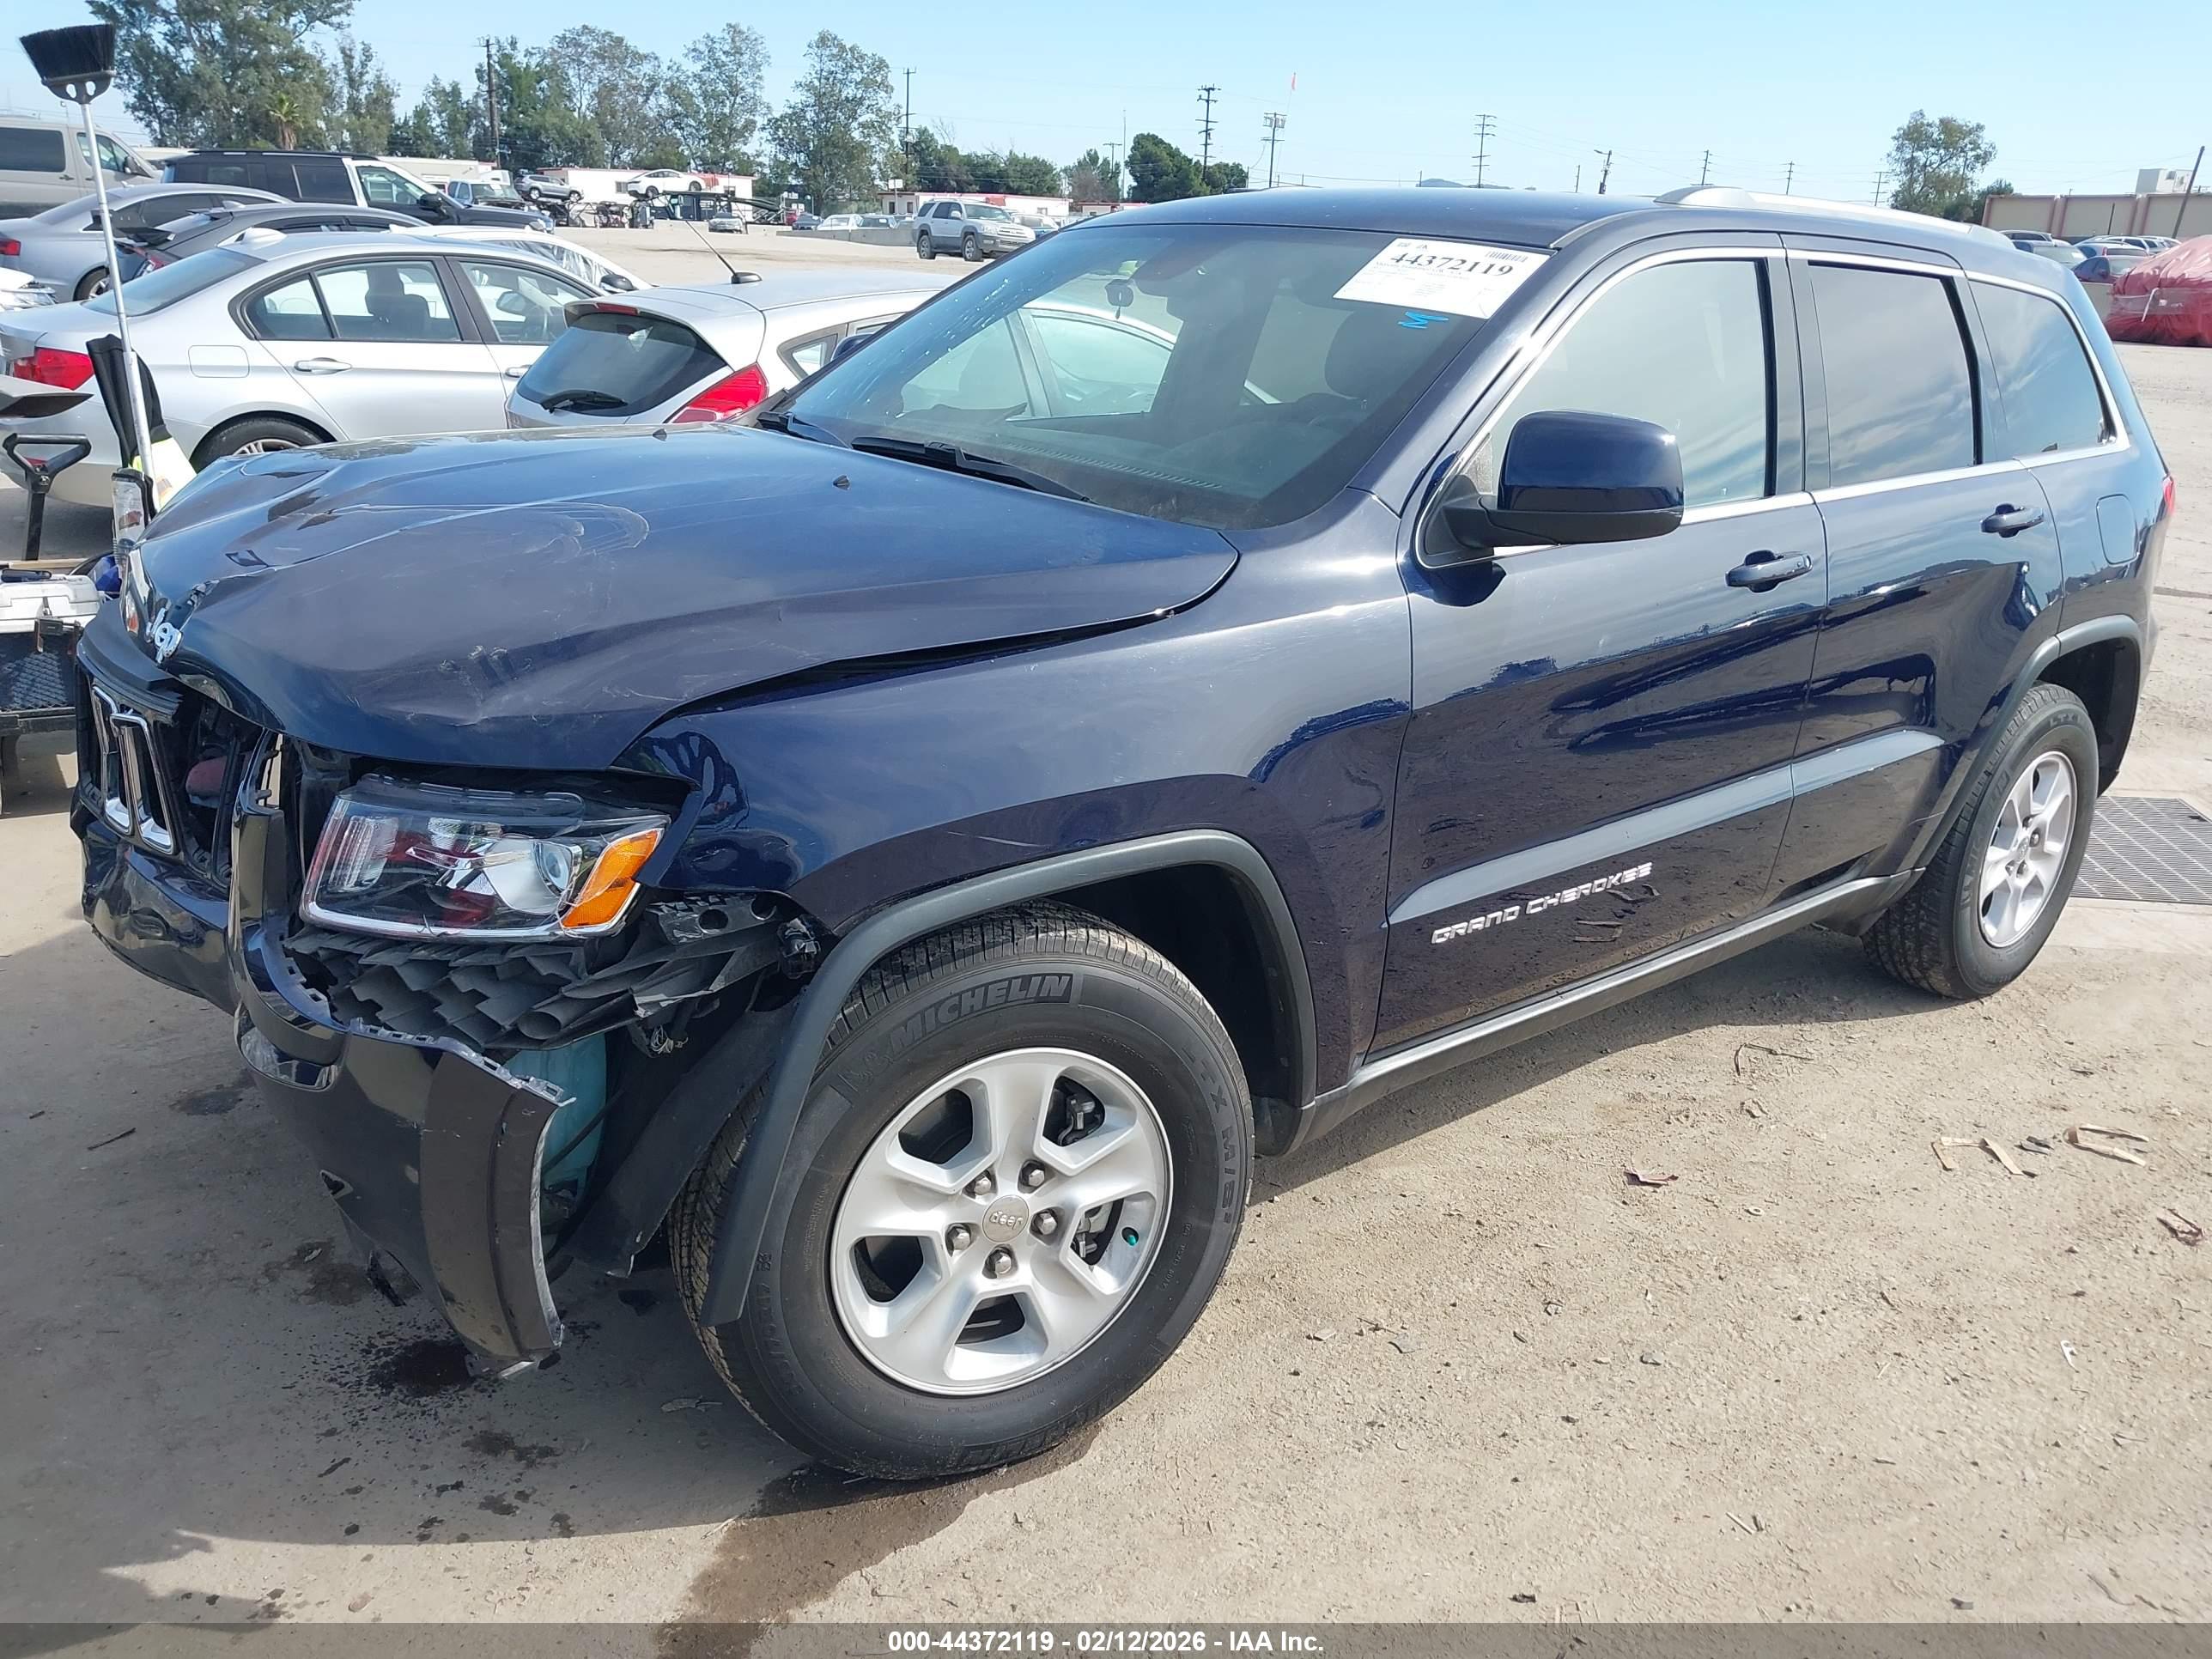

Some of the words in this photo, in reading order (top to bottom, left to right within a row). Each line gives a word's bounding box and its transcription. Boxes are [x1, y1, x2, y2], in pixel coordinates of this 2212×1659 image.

[1389, 252, 1514, 276] 44372119
[1431, 905, 1521, 945] GRAND
[1525, 861, 1653, 915] CHEROKEE
[890, 974, 1071, 1053] MICHELIN
[989, 1210, 1024, 1230] Jeep
